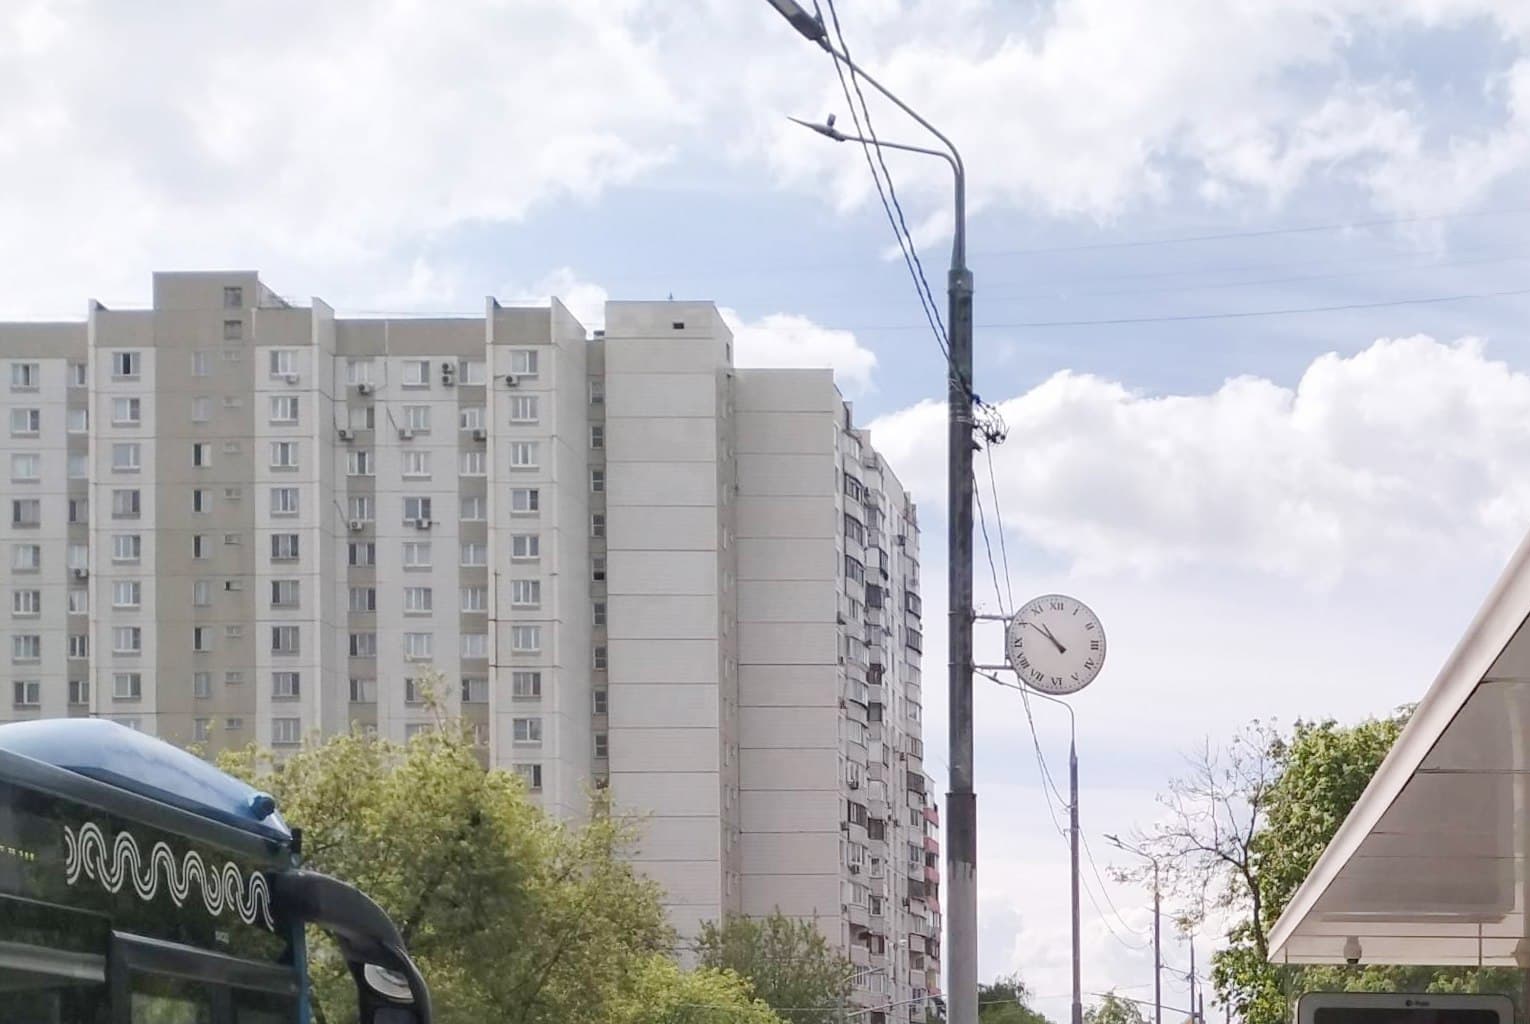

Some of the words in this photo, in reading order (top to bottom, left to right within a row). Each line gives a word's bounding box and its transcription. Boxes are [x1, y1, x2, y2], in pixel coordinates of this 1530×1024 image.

[1031, 604, 1044, 617] XI
[1049, 602, 1064, 611] XII
[1085, 622, 1095, 631] II
[1090, 640, 1099, 650] III
[1029, 669, 1044, 682] VII
[1051, 677, 1063, 686] VI
